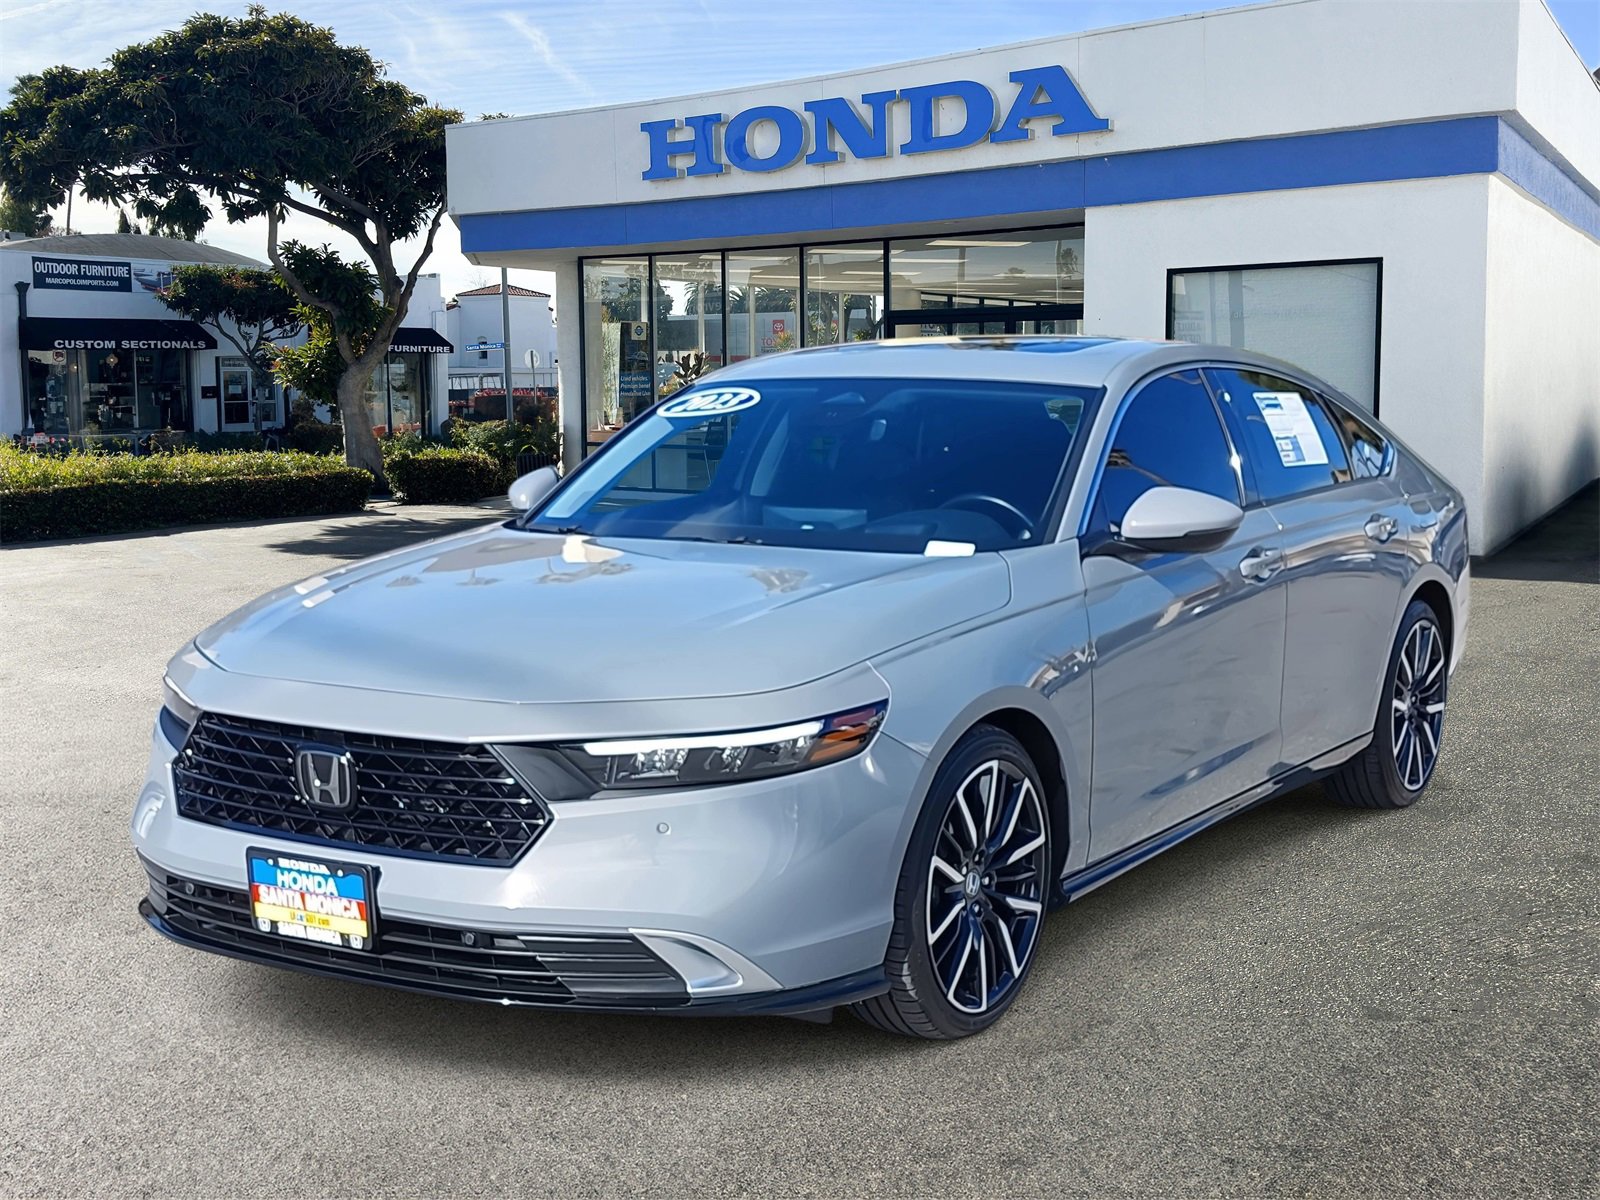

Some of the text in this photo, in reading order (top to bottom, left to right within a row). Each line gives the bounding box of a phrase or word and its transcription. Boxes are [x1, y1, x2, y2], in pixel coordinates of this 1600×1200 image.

[641, 65, 1113, 181] HONDA
[34, 261, 130, 278] OUTDOOR FURNITURE
[45, 277, 119, 287] MARCOPOLOIMPORTS.COM
[54, 339, 206, 349] CUSTOM SECTIONALS
[387, 344, 450, 353] FURNITURE
[277, 857, 331, 875] HONDA
[276, 868, 339, 897] HONDA
[258, 885, 305, 912] SANTA
[304, 893, 362, 921] MONICA
